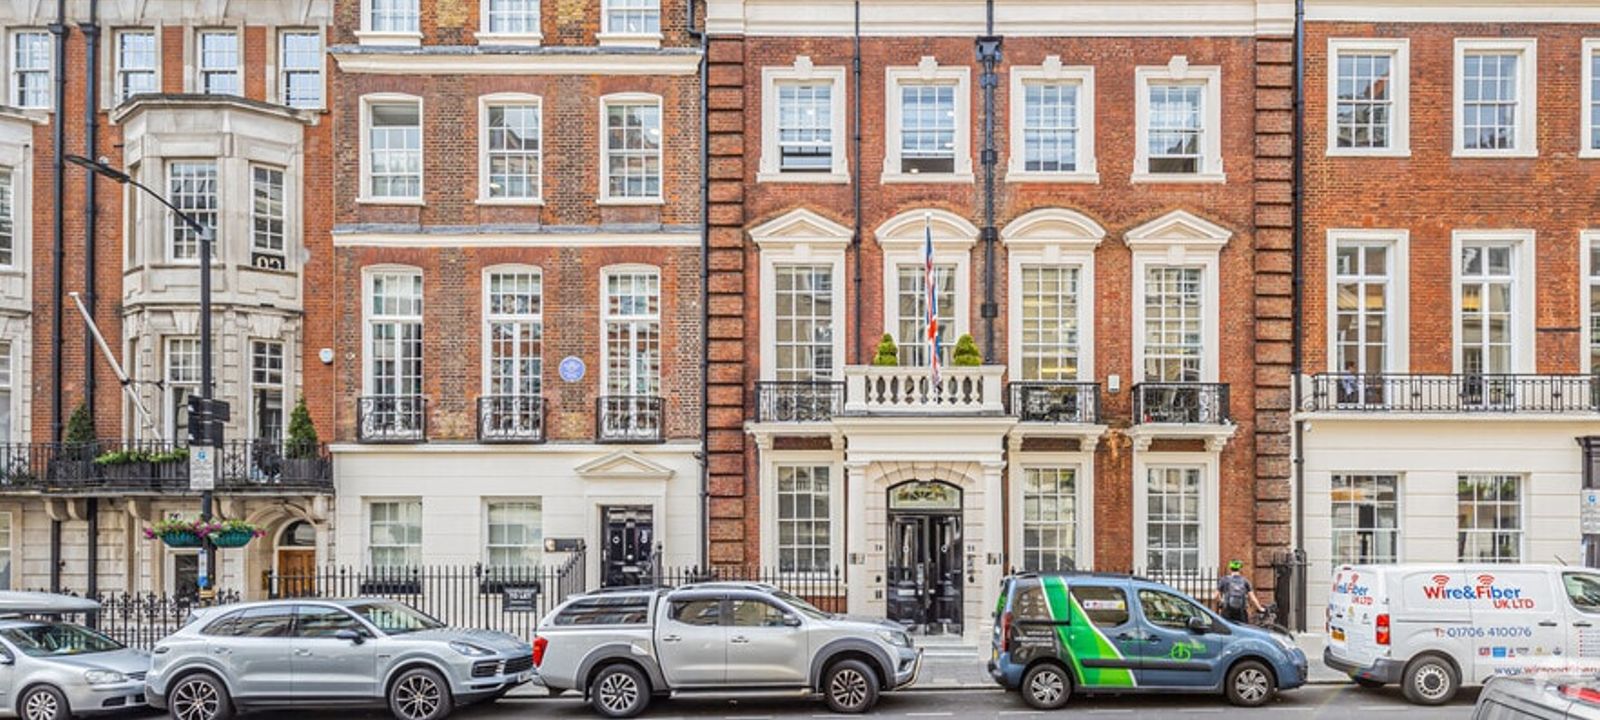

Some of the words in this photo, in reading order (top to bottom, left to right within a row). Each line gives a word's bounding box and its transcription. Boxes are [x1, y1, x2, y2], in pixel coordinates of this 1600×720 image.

[1423, 584, 1521, 599] Wire&Fiber
[1493, 599, 1511, 609] UK
[1512, 599, 1534, 609] LTD
[1446, 627, 1485, 638] 01706
[1487, 627, 1532, 638] 410076
